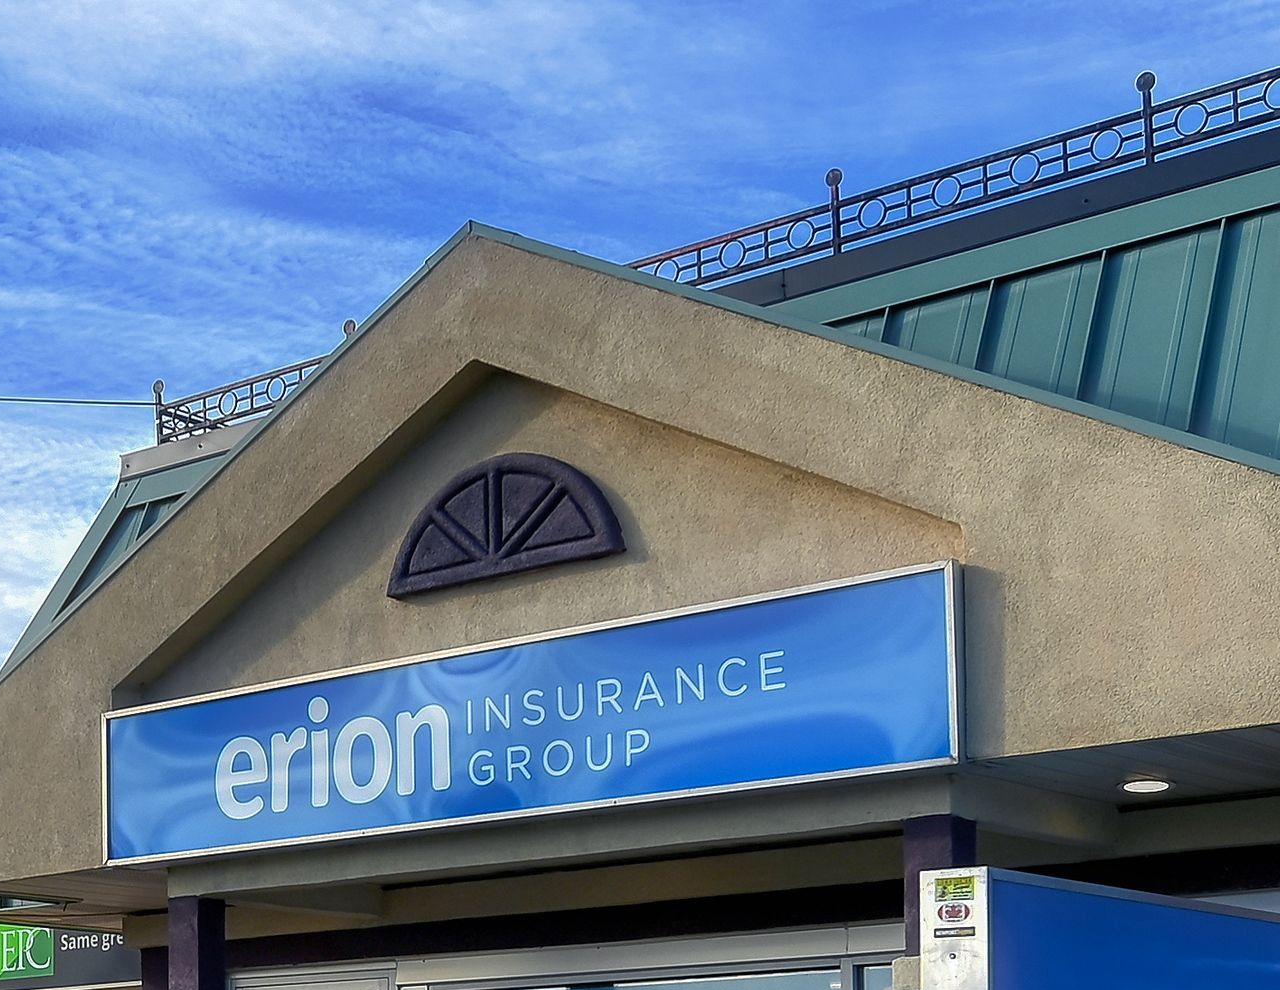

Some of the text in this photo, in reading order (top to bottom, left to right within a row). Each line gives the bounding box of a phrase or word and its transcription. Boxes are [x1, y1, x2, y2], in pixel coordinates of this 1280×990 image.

[465, 650, 787, 735] INSURANCE
[214, 696, 452, 821] erion
[467, 728, 652, 787] GROUP
[1, 926, 51, 972] EPC
[60, 933, 99, 951] Same
